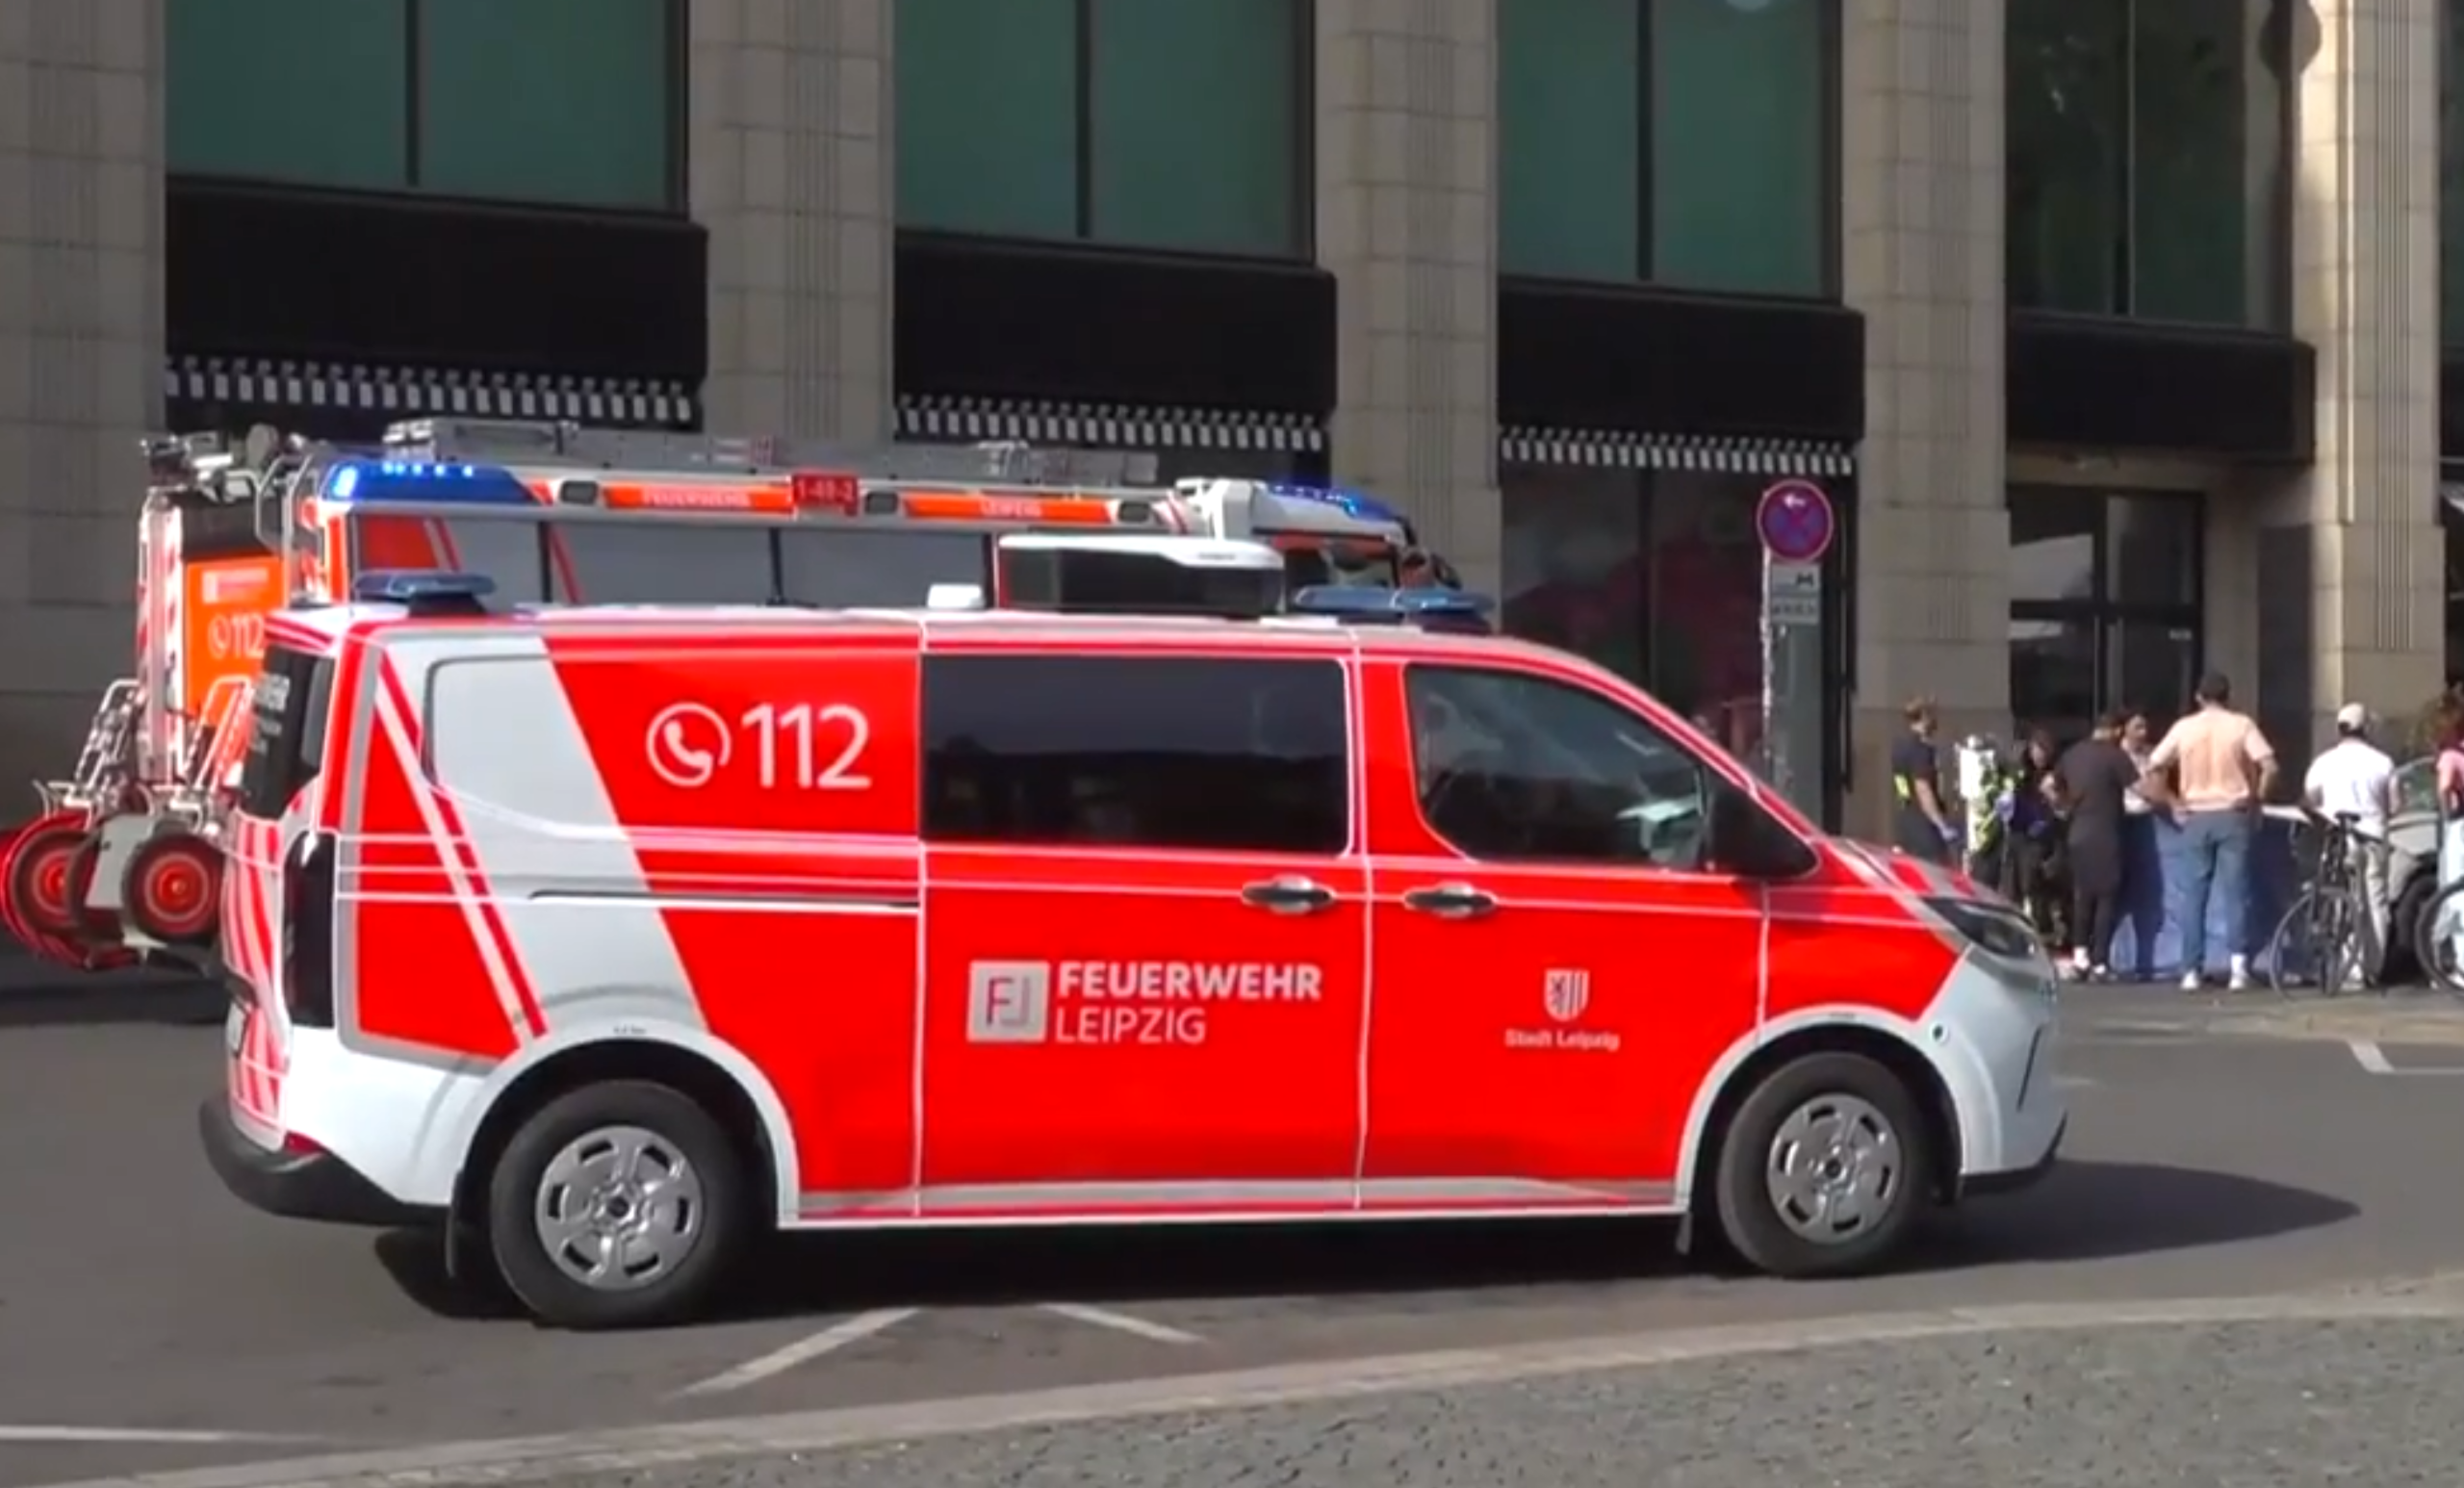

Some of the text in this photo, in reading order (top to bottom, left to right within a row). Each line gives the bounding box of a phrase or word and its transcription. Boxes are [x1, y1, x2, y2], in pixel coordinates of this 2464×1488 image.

[231, 613, 265, 659] 112
[740, 703, 872, 789] 112
[1058, 961, 1323, 1001] FEUERWEHR
[1055, 1006, 1207, 1044] LEIPZIG
[1503, 1027, 1622, 1053] Stadt Leipzig
